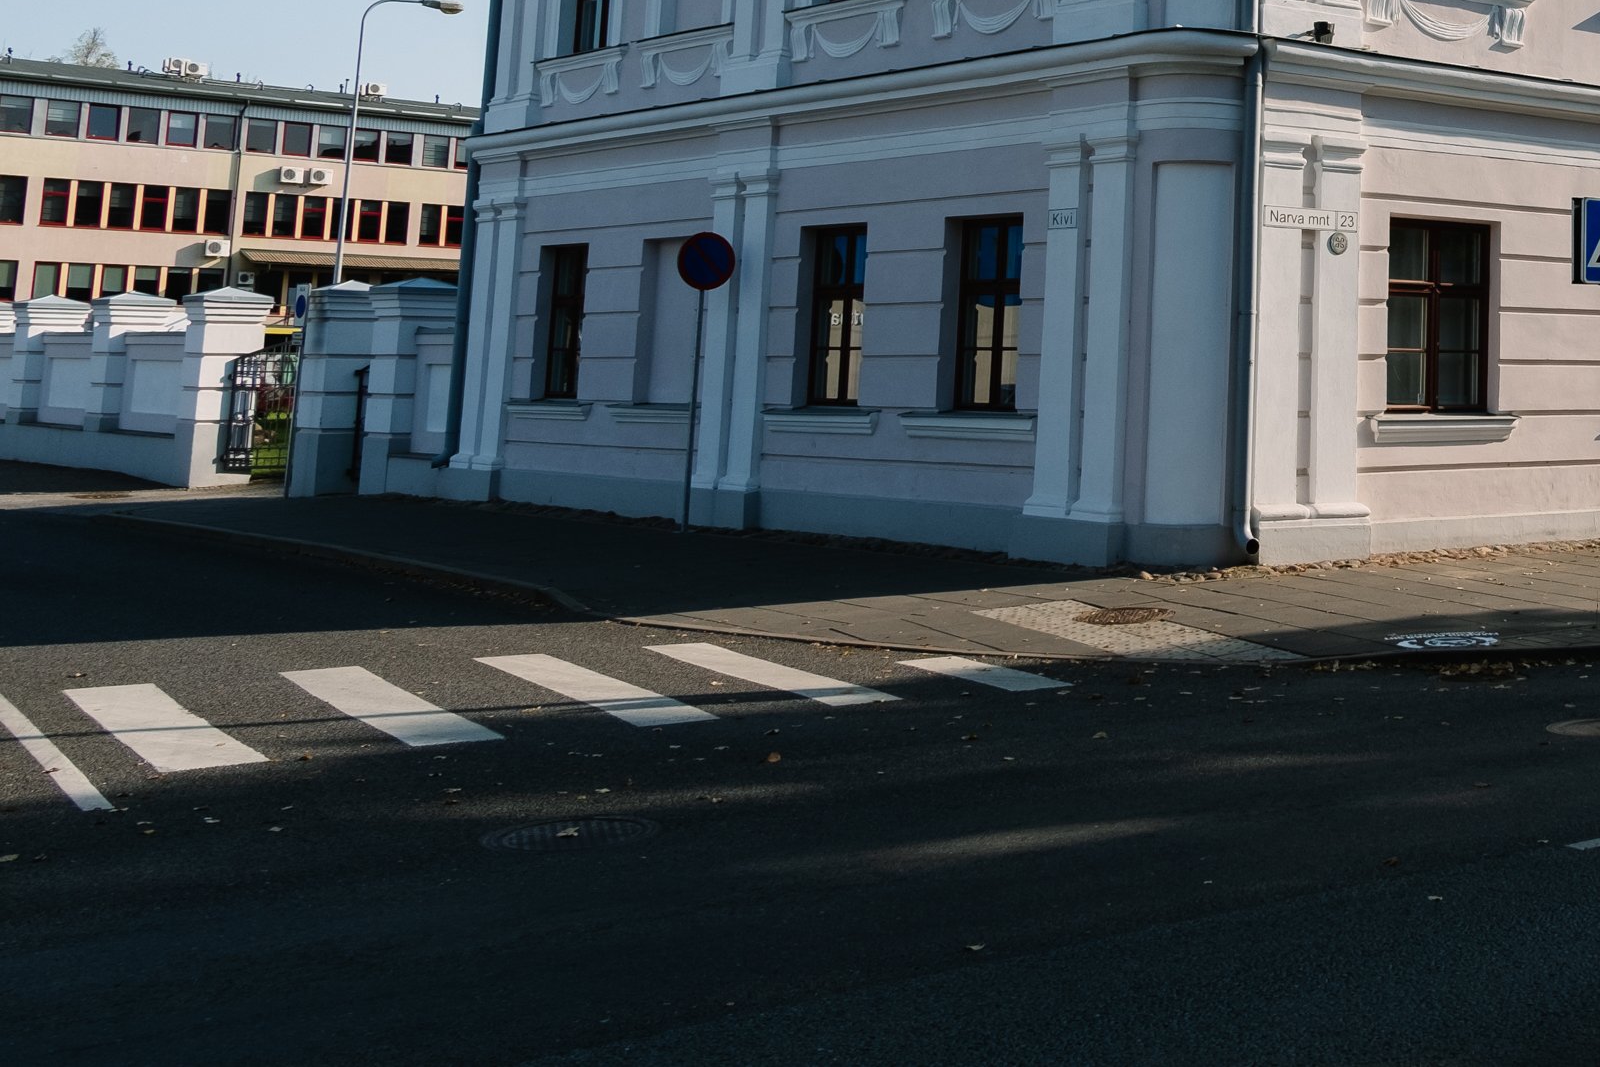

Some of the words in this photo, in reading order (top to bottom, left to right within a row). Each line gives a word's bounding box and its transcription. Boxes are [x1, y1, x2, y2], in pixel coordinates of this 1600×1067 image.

[1052, 212, 1073, 225] Kivi
[1270, 210, 1305, 224] Narva
[1308, 214, 1330, 226] mnt
[1340, 214, 1355, 228] 23
